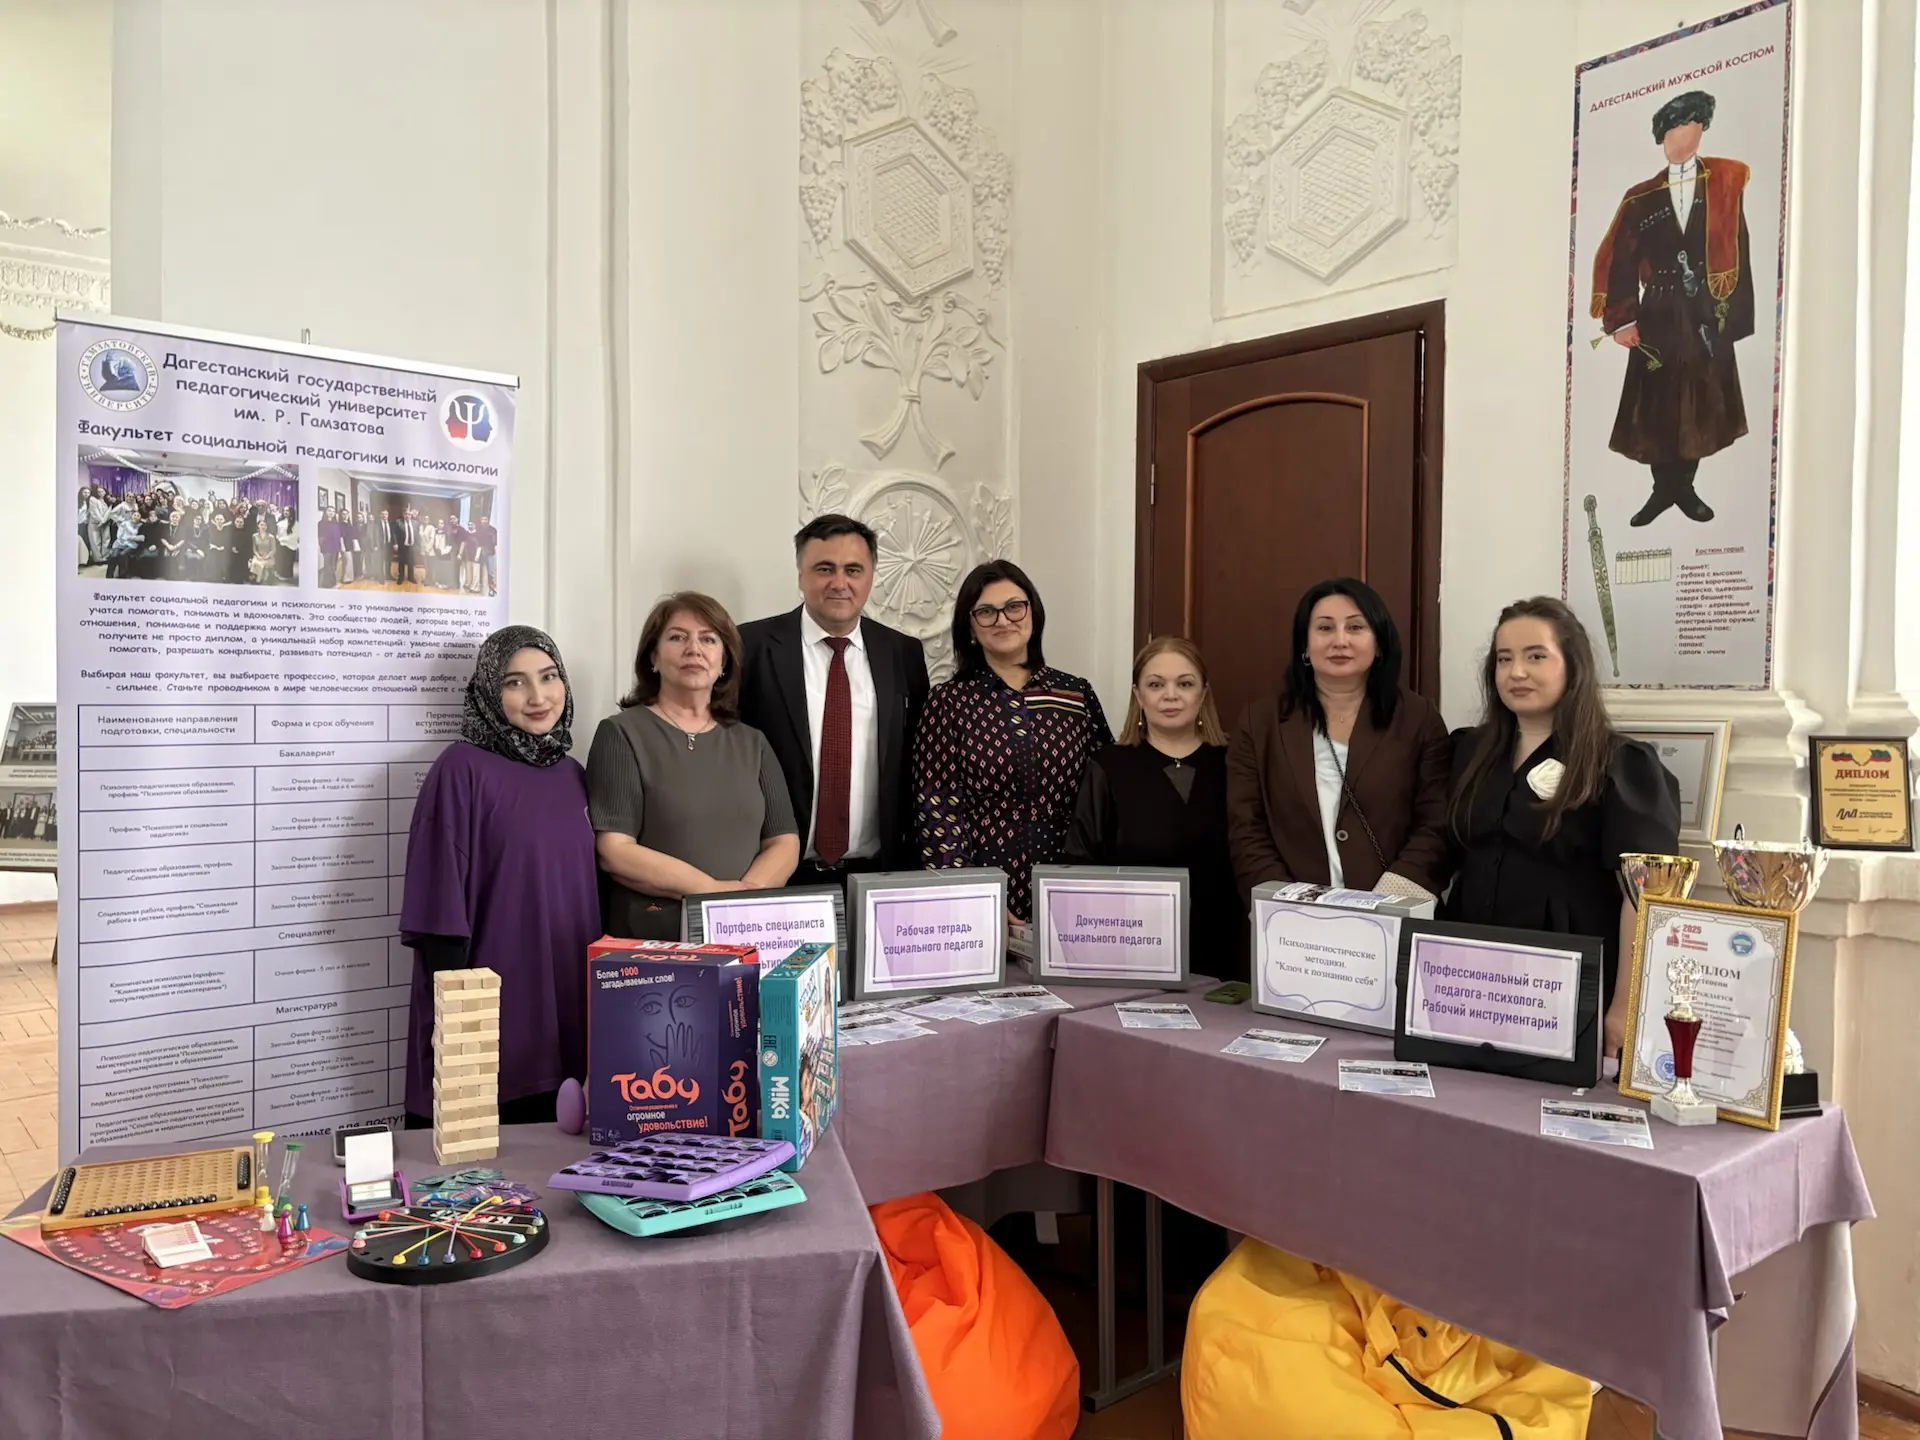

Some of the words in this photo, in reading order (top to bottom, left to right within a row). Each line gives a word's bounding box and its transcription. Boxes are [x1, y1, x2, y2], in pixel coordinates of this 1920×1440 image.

[1589, 79, 1665, 112] ДАГЕСТАНСКИЙ
[1668, 60, 1722, 86] МУЖСКОЙ
[1725, 45, 1774, 68] КОСТЮМ
[162, 352, 288, 383] Дагестанский
[297, 374, 436, 403] государственный
[176, 379, 320, 407] педагогический
[328, 399, 426, 420] университет
[234, 408, 265, 421] им.
[275, 409, 290, 424] Р.
[300, 412, 384, 435] Гамзатова
[78, 419, 173, 441] Факультет
[181, 433, 287, 453] социальной
[296, 445, 387, 464] педагогики
[395, 456, 404, 466] и
[413, 458, 497, 476] психологии
[93, 592, 145, 603] Факультет
[149, 595, 208, 604] социальной
[212, 598, 267, 606] педагогики
[417, 607, 470, 616] пространство,
[88, 607, 123, 616] учатся
[128, 608, 178, 617] помогать,
[243, 612, 304, 620] вдохновлять.
[309, 612, 324, 620] Это
[327, 614, 377, 623] сообщество
[380, 616, 411, 624] людей,
[416, 618, 448, 626] которые
[79, 619, 140, 628] отношения,
[146, 621, 200, 629] понимание
[215, 623, 266, 632] поддержка
[269, 625, 296, 633] могут
[421, 630, 457, 638] лучшему.
[462, 630, 483, 638] Здесь
[98, 633, 147, 642] получите
[168, 634, 201, 642] просто
[204, 635, 246, 643] диплом,
[260, 636, 315, 645] уникальный
[319, 637, 344, 646] набор
[409, 640, 440, 648] умение
[109, 646, 160, 654] помогать,
[166, 647, 214, 655] разрешать
[218, 648, 274, 656] конфликты,
[279, 649, 322, 657] развивать
[396, 651, 421, 659] детей
[80, 669, 126, 680] Выбирая
[154, 672, 208, 680] факультет,
[230, 671, 279, 681] выбираете
[283, 673, 338, 681] профессию,
[430, 674, 459, 682] добрее,
[166, 683, 202, 691] Станьте
[207, 685, 270, 693] проводником
[282, 685, 305, 693] мире
[97, 715, 173, 723] Наименование
[175, 716, 237, 724] направления
[271, 719, 302, 728] Форма
[334, 718, 374, 728] обучения
[100, 728, 161, 736] подготовки,
[279, 749, 335, 758] Бакалавриат
[1835, 769, 1889, 780] ДИПЛОМ
[716, 921, 762, 936] Портфель
[765, 919, 824, 932] специалиста
[1075, 914, 1142, 929] Документация
[1683, 924, 1701, 934] 2025
[278, 929, 334, 940] Специалитет
[896, 924, 934, 936] Рабочая
[937, 923, 972, 936] тетрадь
[883, 942, 941, 955] социального
[944, 939, 983, 951] педагога
[1057, 933, 1116, 944] социального
[1119, 935, 1161, 946] педагога
[1279, 936, 1375, 960] Психодиагностические
[1304, 955, 1346, 968] методики.
[596, 970, 619, 980] Более
[620, 967, 638, 977] 1000
[1275, 961, 1302, 973] "Ключ
[1311, 969, 1352, 982] познанию
[1354, 976, 1378, 986] себя"
[1423, 961, 1528, 986] Профессиональный
[1532, 978, 1562, 993] старт
[1700, 965, 1740, 980] ПЛОМ
[601, 977, 654, 989] загадываемых
[655, 972, 675, 984] слов!
[1434, 984, 1546, 1008] педагога-психолога.
[275, 1001, 337, 1014] Магистратура
[1422, 998, 1465, 1016] Рабочий
[1469, 1008, 1557, 1030] инструментарий
[611, 1064, 700, 1106] Табу
[720, 1060, 750, 1137] Табу
[627, 1111, 666, 1122] огромное
[638, 1116, 708, 1133] удовольствие!
